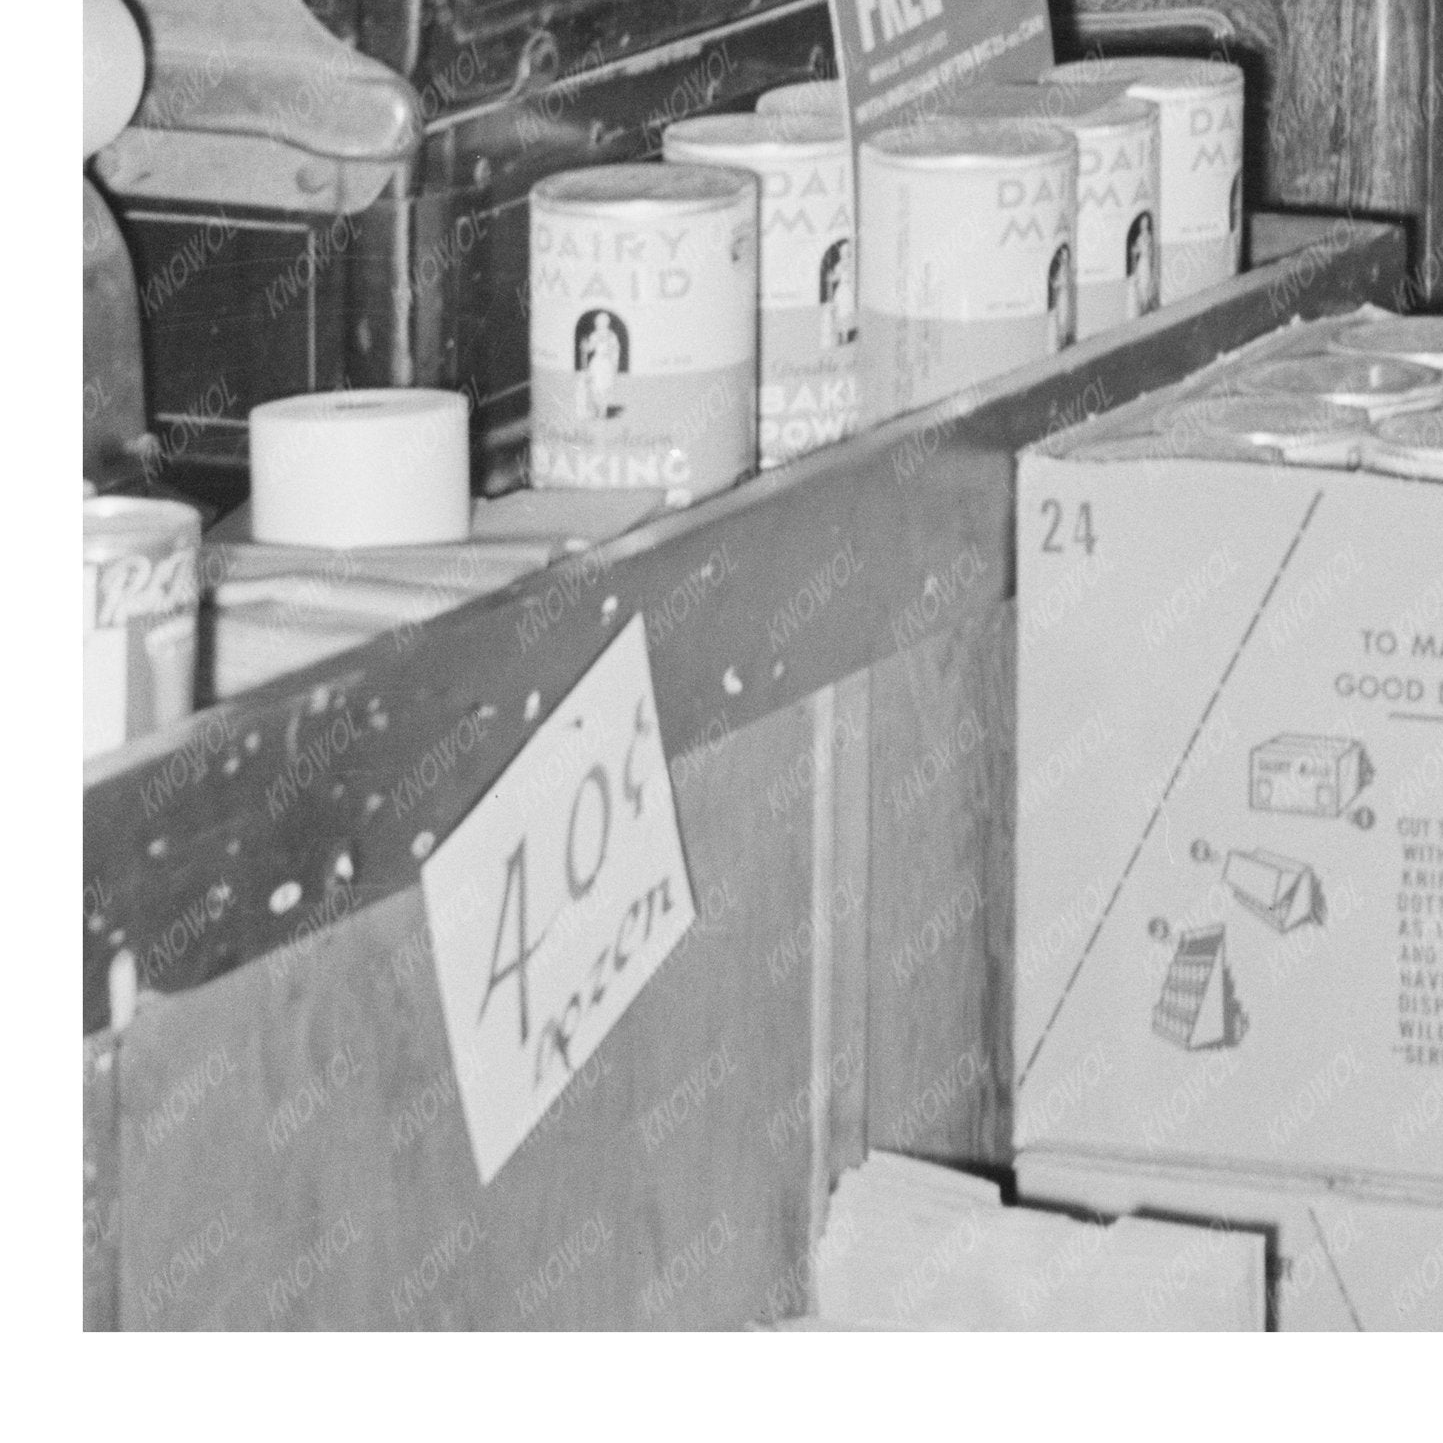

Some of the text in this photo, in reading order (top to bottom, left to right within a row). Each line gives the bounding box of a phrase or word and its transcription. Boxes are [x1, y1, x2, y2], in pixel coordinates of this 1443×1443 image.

[1038, 497, 1100, 555] 24
[1361, 629, 1398, 656] TO
[1334, 672, 1424, 703] GOOD
[1398, 944, 1437, 966] AND
